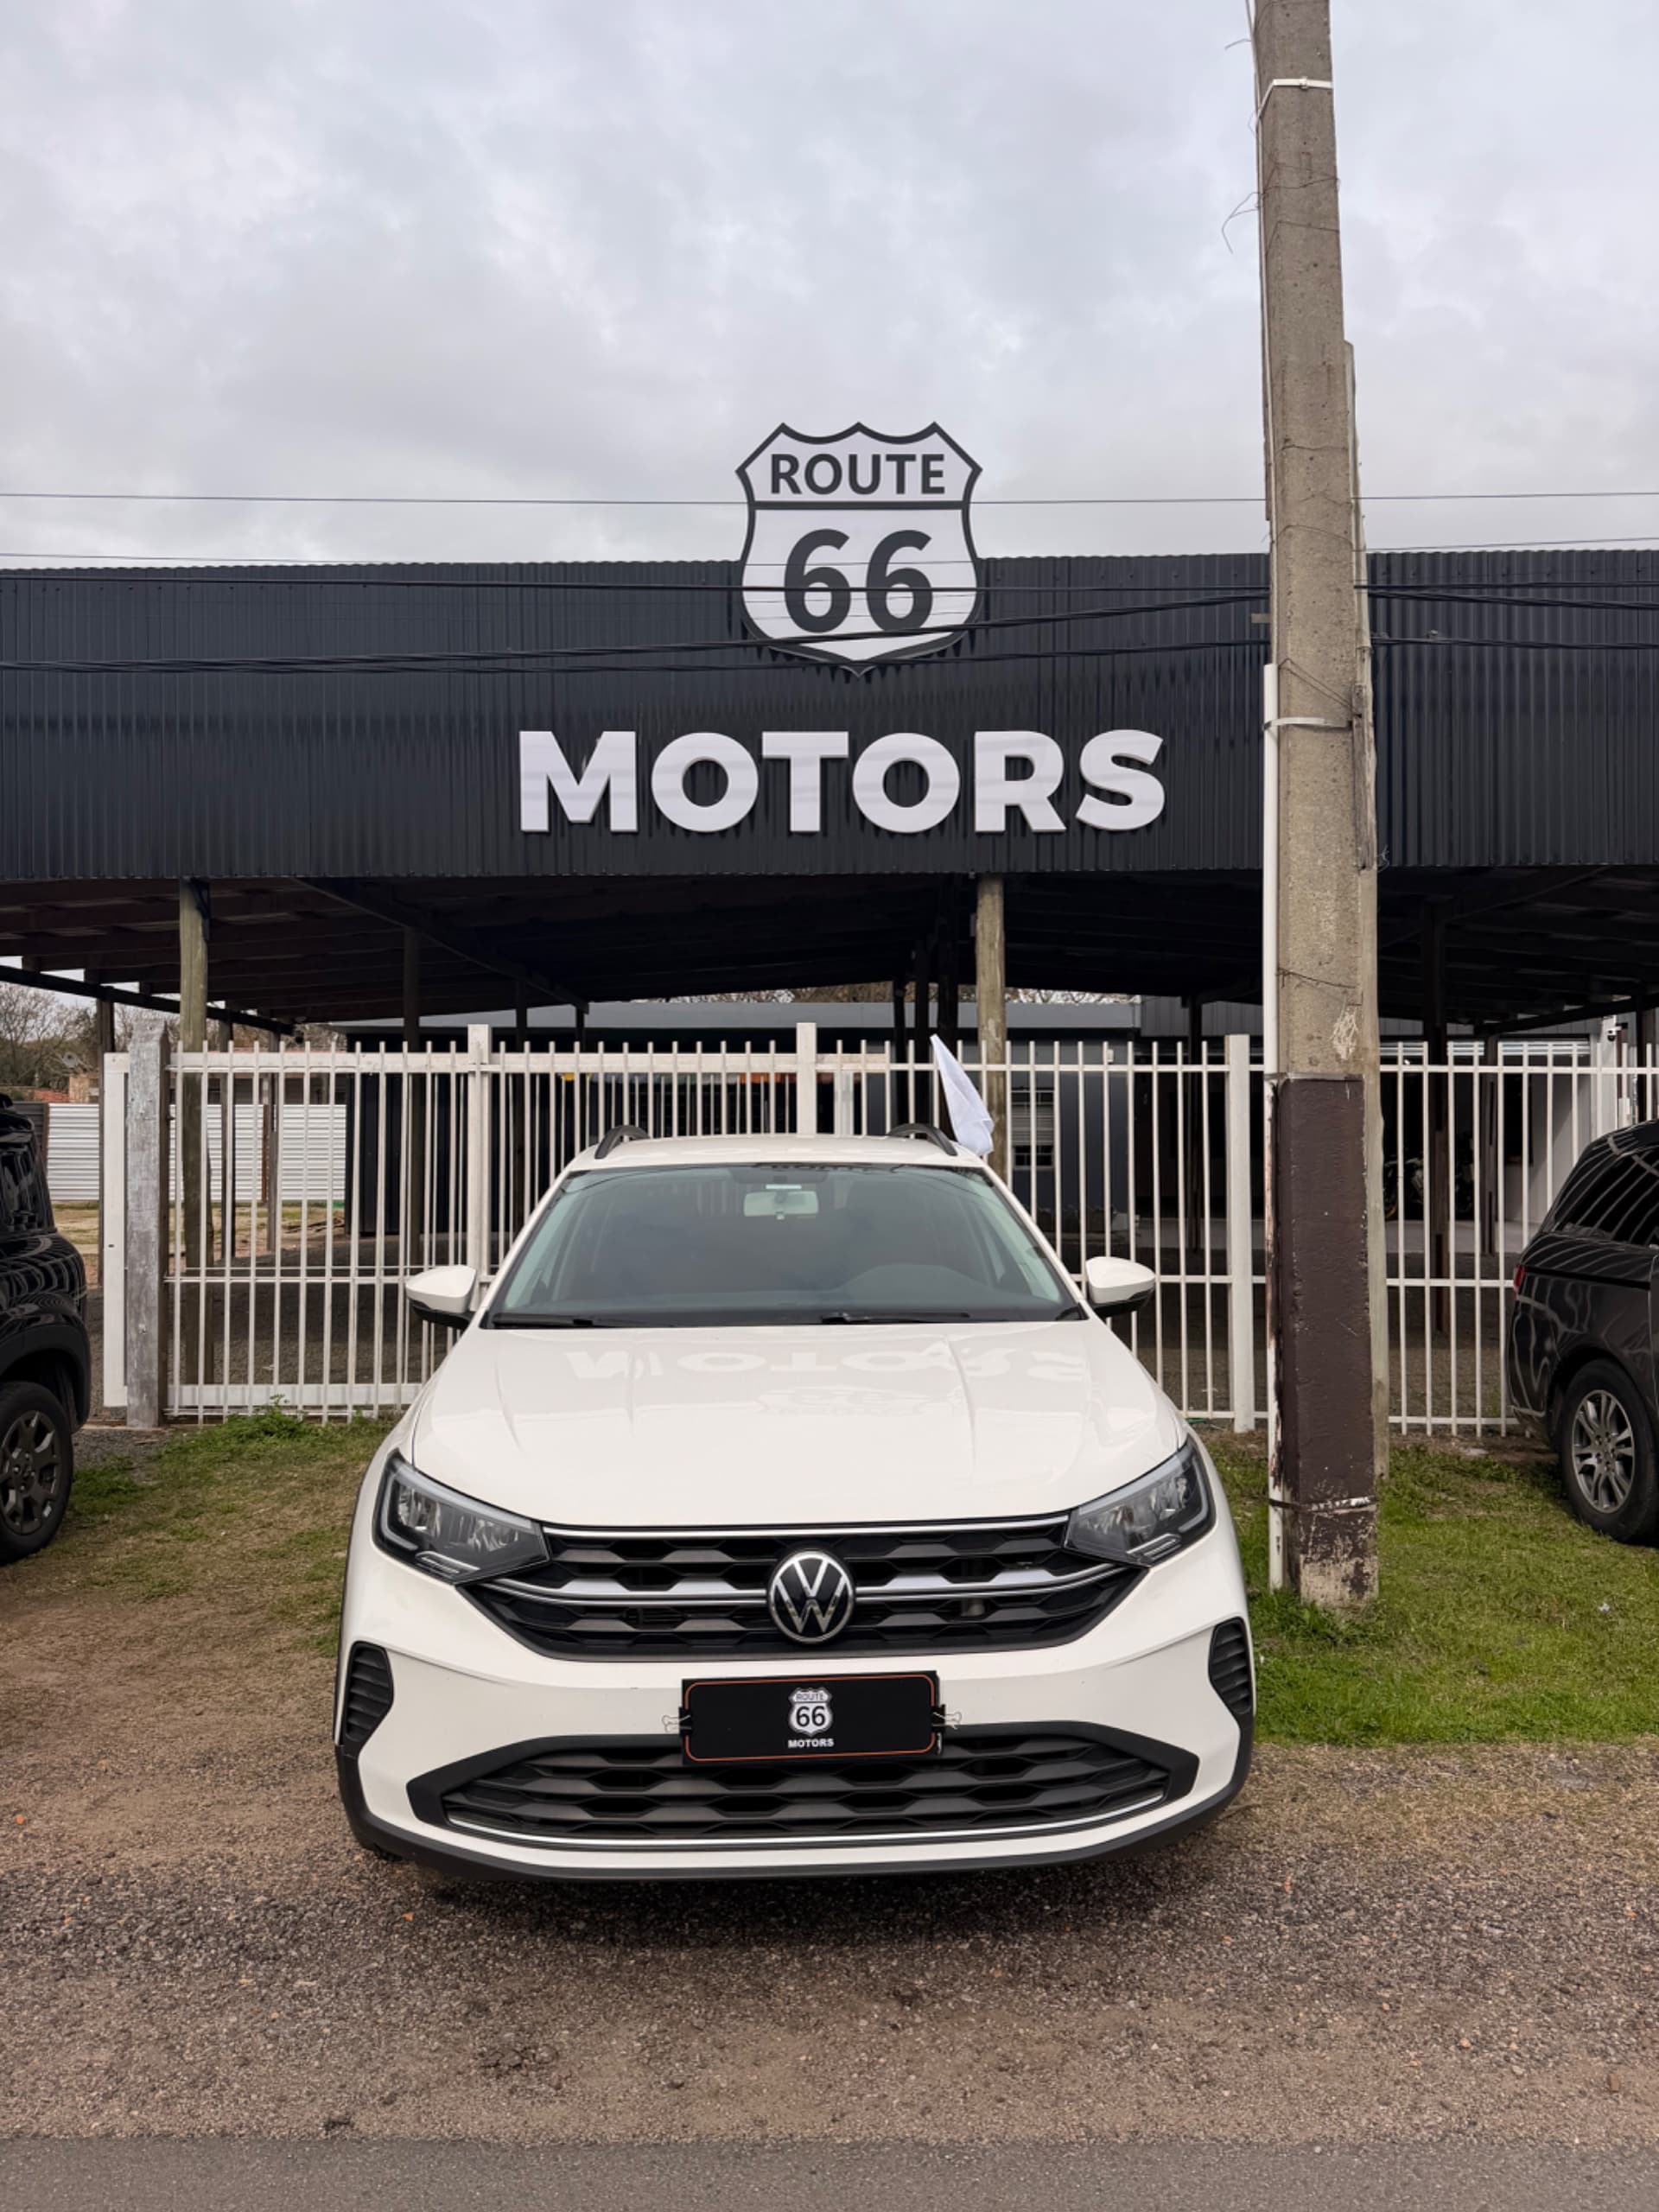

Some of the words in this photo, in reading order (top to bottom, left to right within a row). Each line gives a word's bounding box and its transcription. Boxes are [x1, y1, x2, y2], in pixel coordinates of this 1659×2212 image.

[771, 454, 945, 495] ROUTE
[784, 528, 933, 634] 66
[518, 729, 1166, 833] MOTORS
[796, 1706, 825, 1726] 66
[787, 1738, 835, 1748] MOTORS
